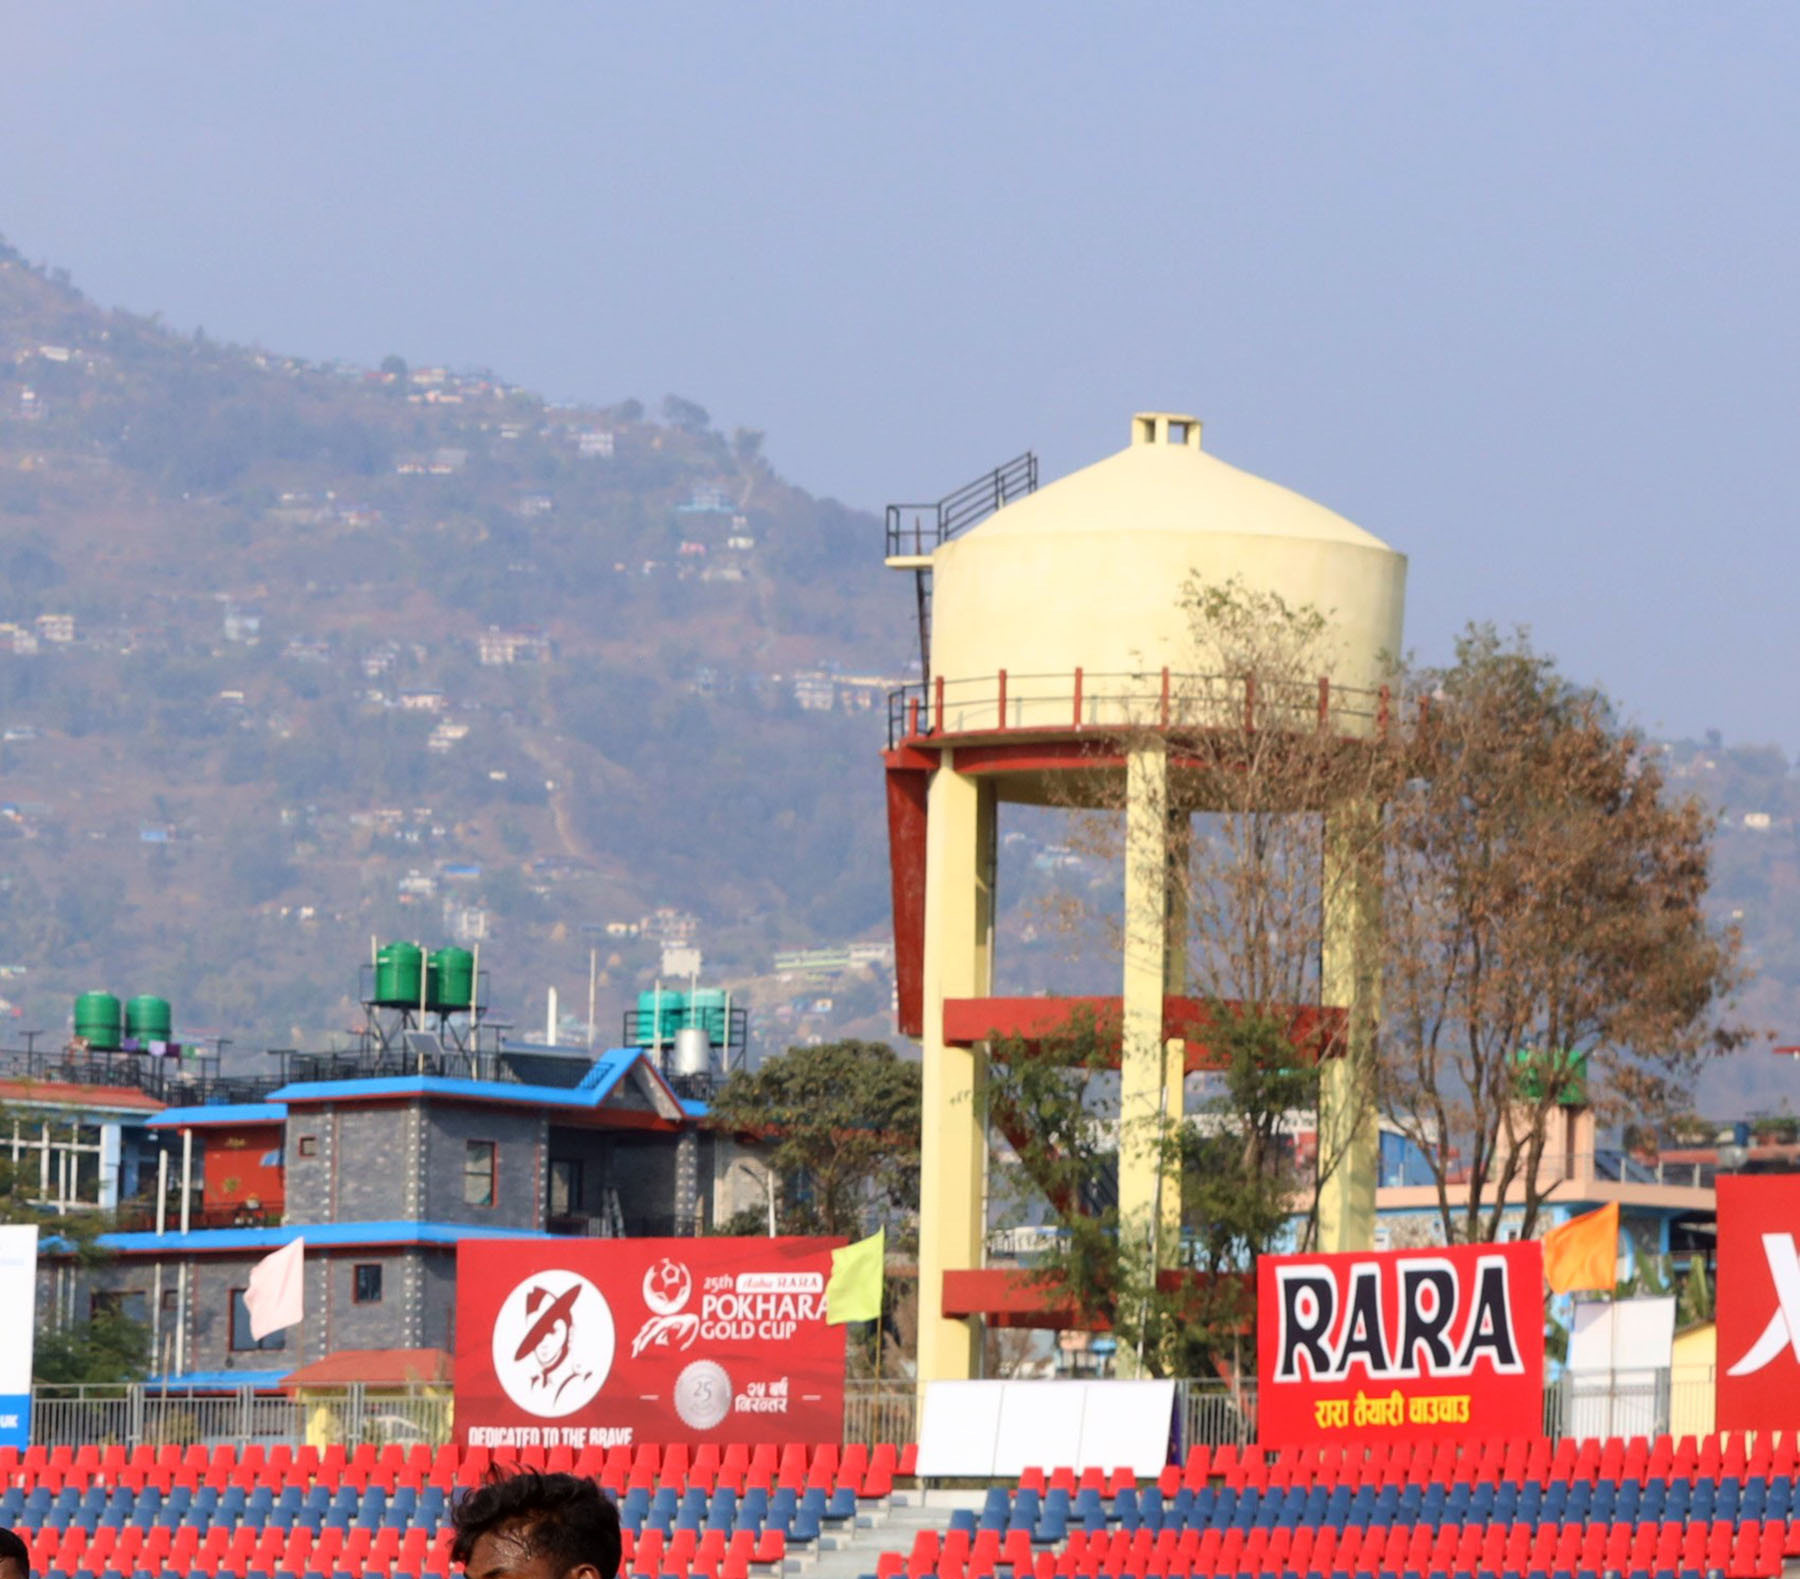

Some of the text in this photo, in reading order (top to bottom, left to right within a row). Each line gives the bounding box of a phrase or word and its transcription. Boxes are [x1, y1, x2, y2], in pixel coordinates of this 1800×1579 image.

[703, 1274, 734, 1293] 25th
[702, 1294, 828, 1321] POKHARA
[1274, 1255, 1524, 1384] RARA
[701, 1321, 797, 1340] GOLD CUP
[694, 1380, 712, 1401] 25
[0, 1414, 18, 1428] UK
[1315, 1400, 1349, 1429] रारा
[468, 1427, 633, 1448] DEDICATED TO THE BRAVE
